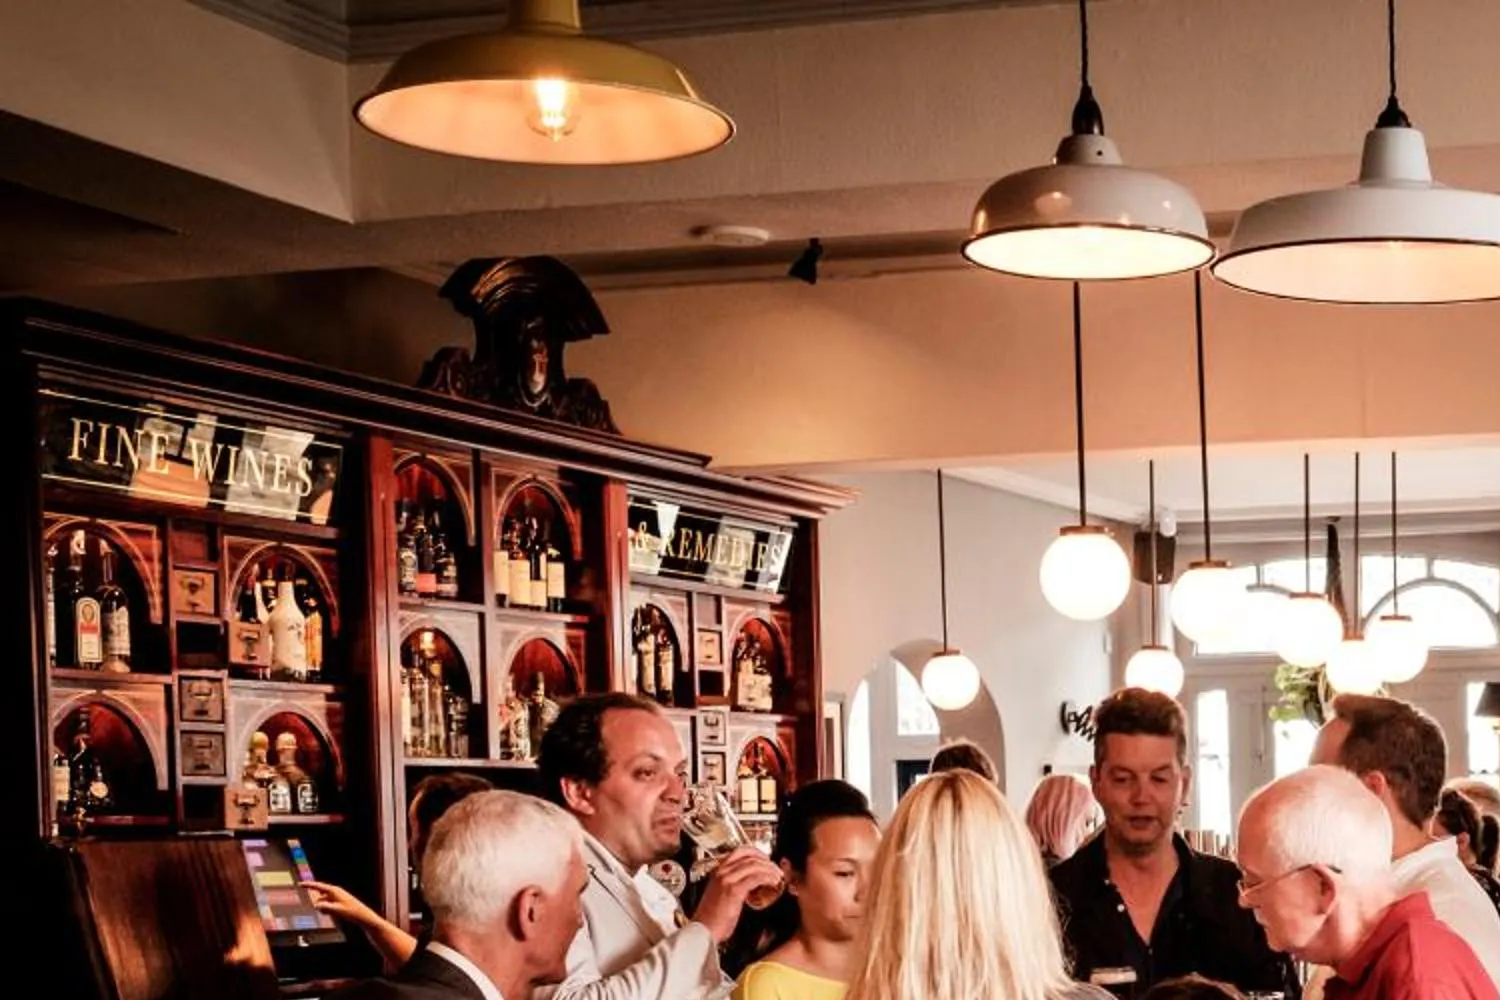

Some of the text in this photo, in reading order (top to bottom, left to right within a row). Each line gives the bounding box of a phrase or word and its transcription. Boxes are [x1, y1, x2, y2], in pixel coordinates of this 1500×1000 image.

[67, 417, 314, 497] FINE WINES
[661, 526, 782, 573] REMEDIES
